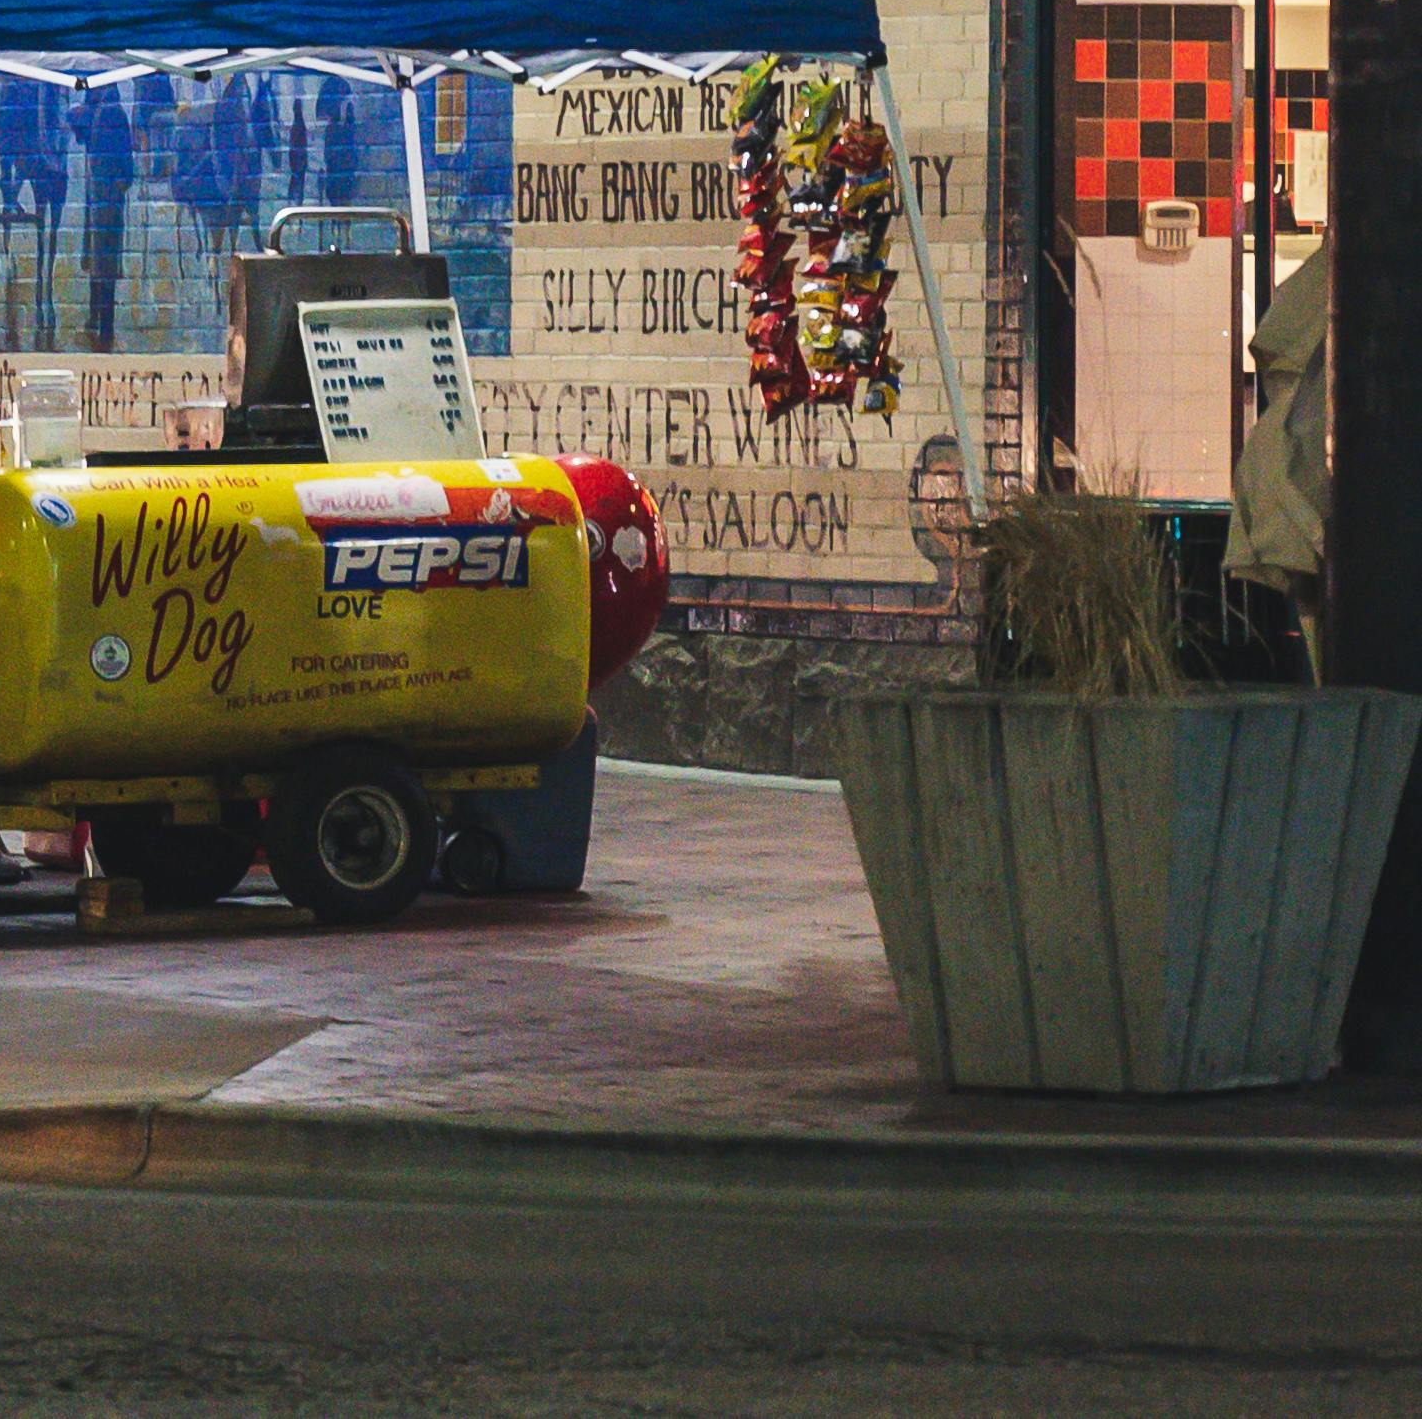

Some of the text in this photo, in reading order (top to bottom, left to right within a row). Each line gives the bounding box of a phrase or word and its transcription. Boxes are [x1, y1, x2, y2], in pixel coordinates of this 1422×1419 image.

[556, 85, 684, 138] MEXICAN
[517, 162, 588, 223] BANG
[601, 160, 679, 223] BANG
[543, 267, 739, 335] SILLY BIRCH
[557, 384, 714, 468] CENTER
[91, 492, 251, 607] Willy
[704, 491, 850, 552] SALOON
[332, 537, 523, 584] PEPSI
[317, 595, 382, 619] LOVE
[145, 586, 254, 694] Dog
[291, 651, 409, 674] FOR CATERING
